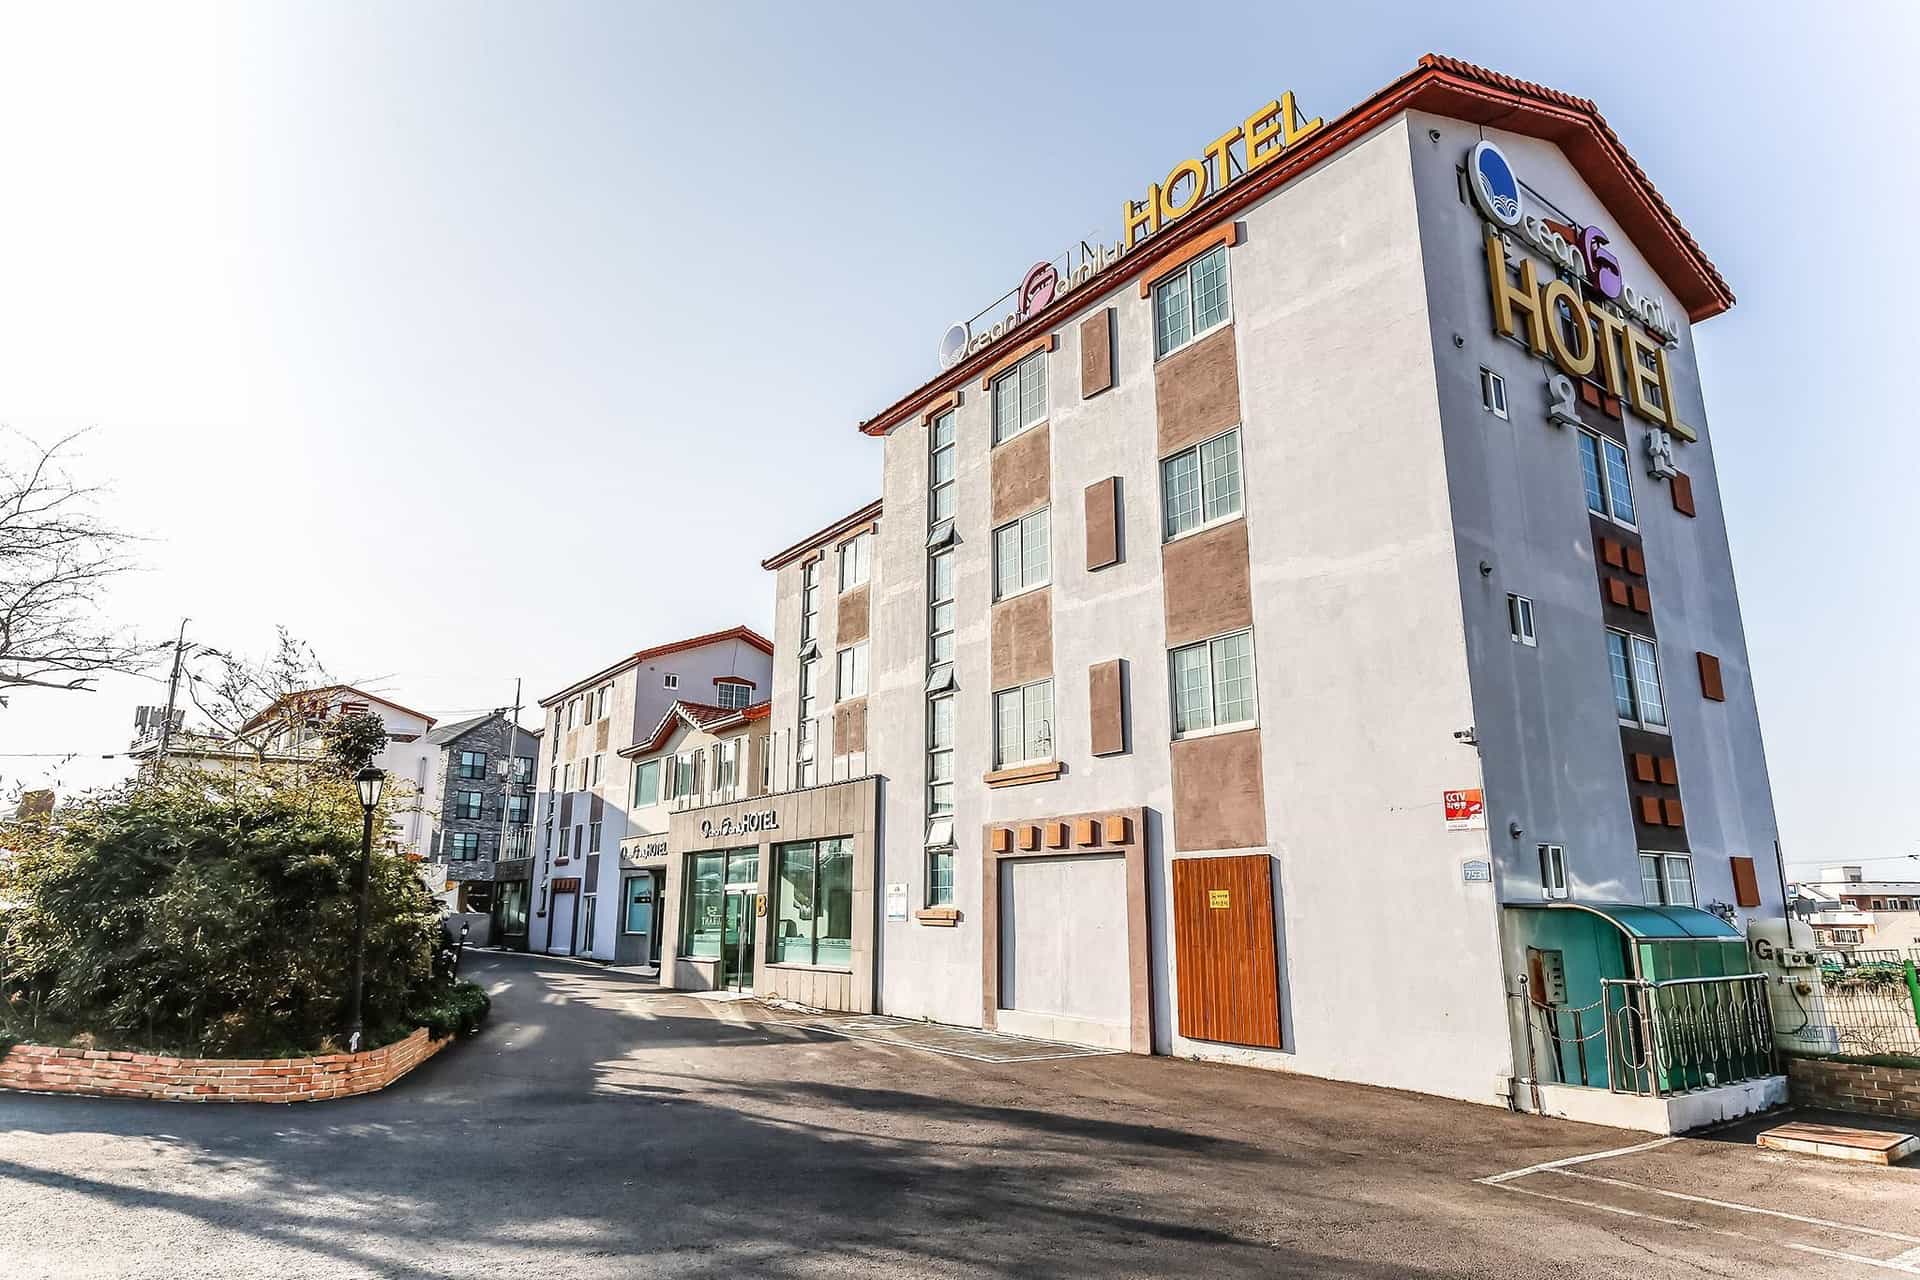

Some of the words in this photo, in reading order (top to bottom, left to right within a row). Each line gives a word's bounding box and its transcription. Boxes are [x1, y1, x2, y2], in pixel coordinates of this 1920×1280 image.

[1122, 89, 1323, 250] HOTEL
[1484, 234, 1697, 443] HOTEL
[1446, 791, 1466, 802] CCTV
[743, 809, 779, 833] HOTEL
[646, 841, 668, 857] HOTEL
[755, 894, 767, 918] B
